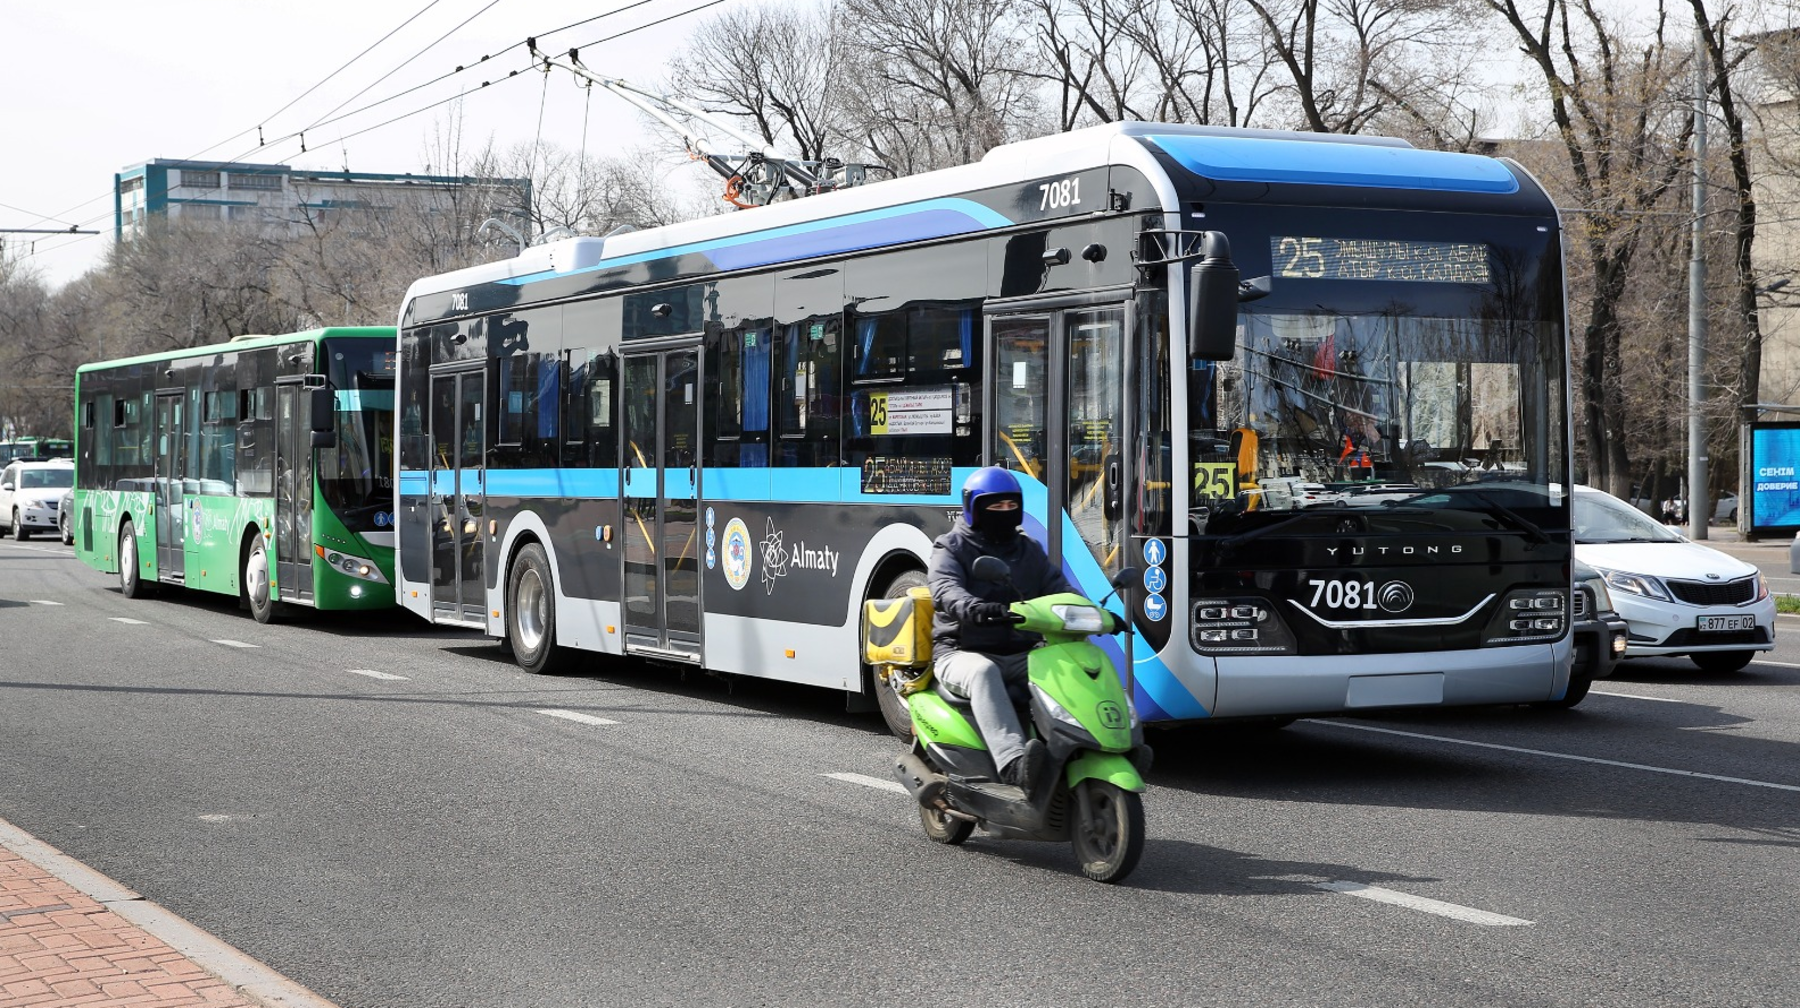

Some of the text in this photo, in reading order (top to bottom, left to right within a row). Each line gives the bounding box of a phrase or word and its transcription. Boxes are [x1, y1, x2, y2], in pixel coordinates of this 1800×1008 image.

[1039, 177, 1081, 211] 7081
[1279, 236, 1325, 278] 25
[452, 293, 468, 310] 7081
[871, 398, 886, 426] 25
[864, 456, 886, 493] 25
[1194, 466, 1230, 499] 25
[1757, 482, 1798, 492] ДОВЕРИЕ
[790, 540, 839, 577] Almaty
[1327, 545, 1462, 556] YUTONG
[1309, 579, 1378, 609] 7081
[1708, 618, 1725, 630] 877
[1727, 620, 1739, 629] EF
[1742, 617, 1753, 629] 02
